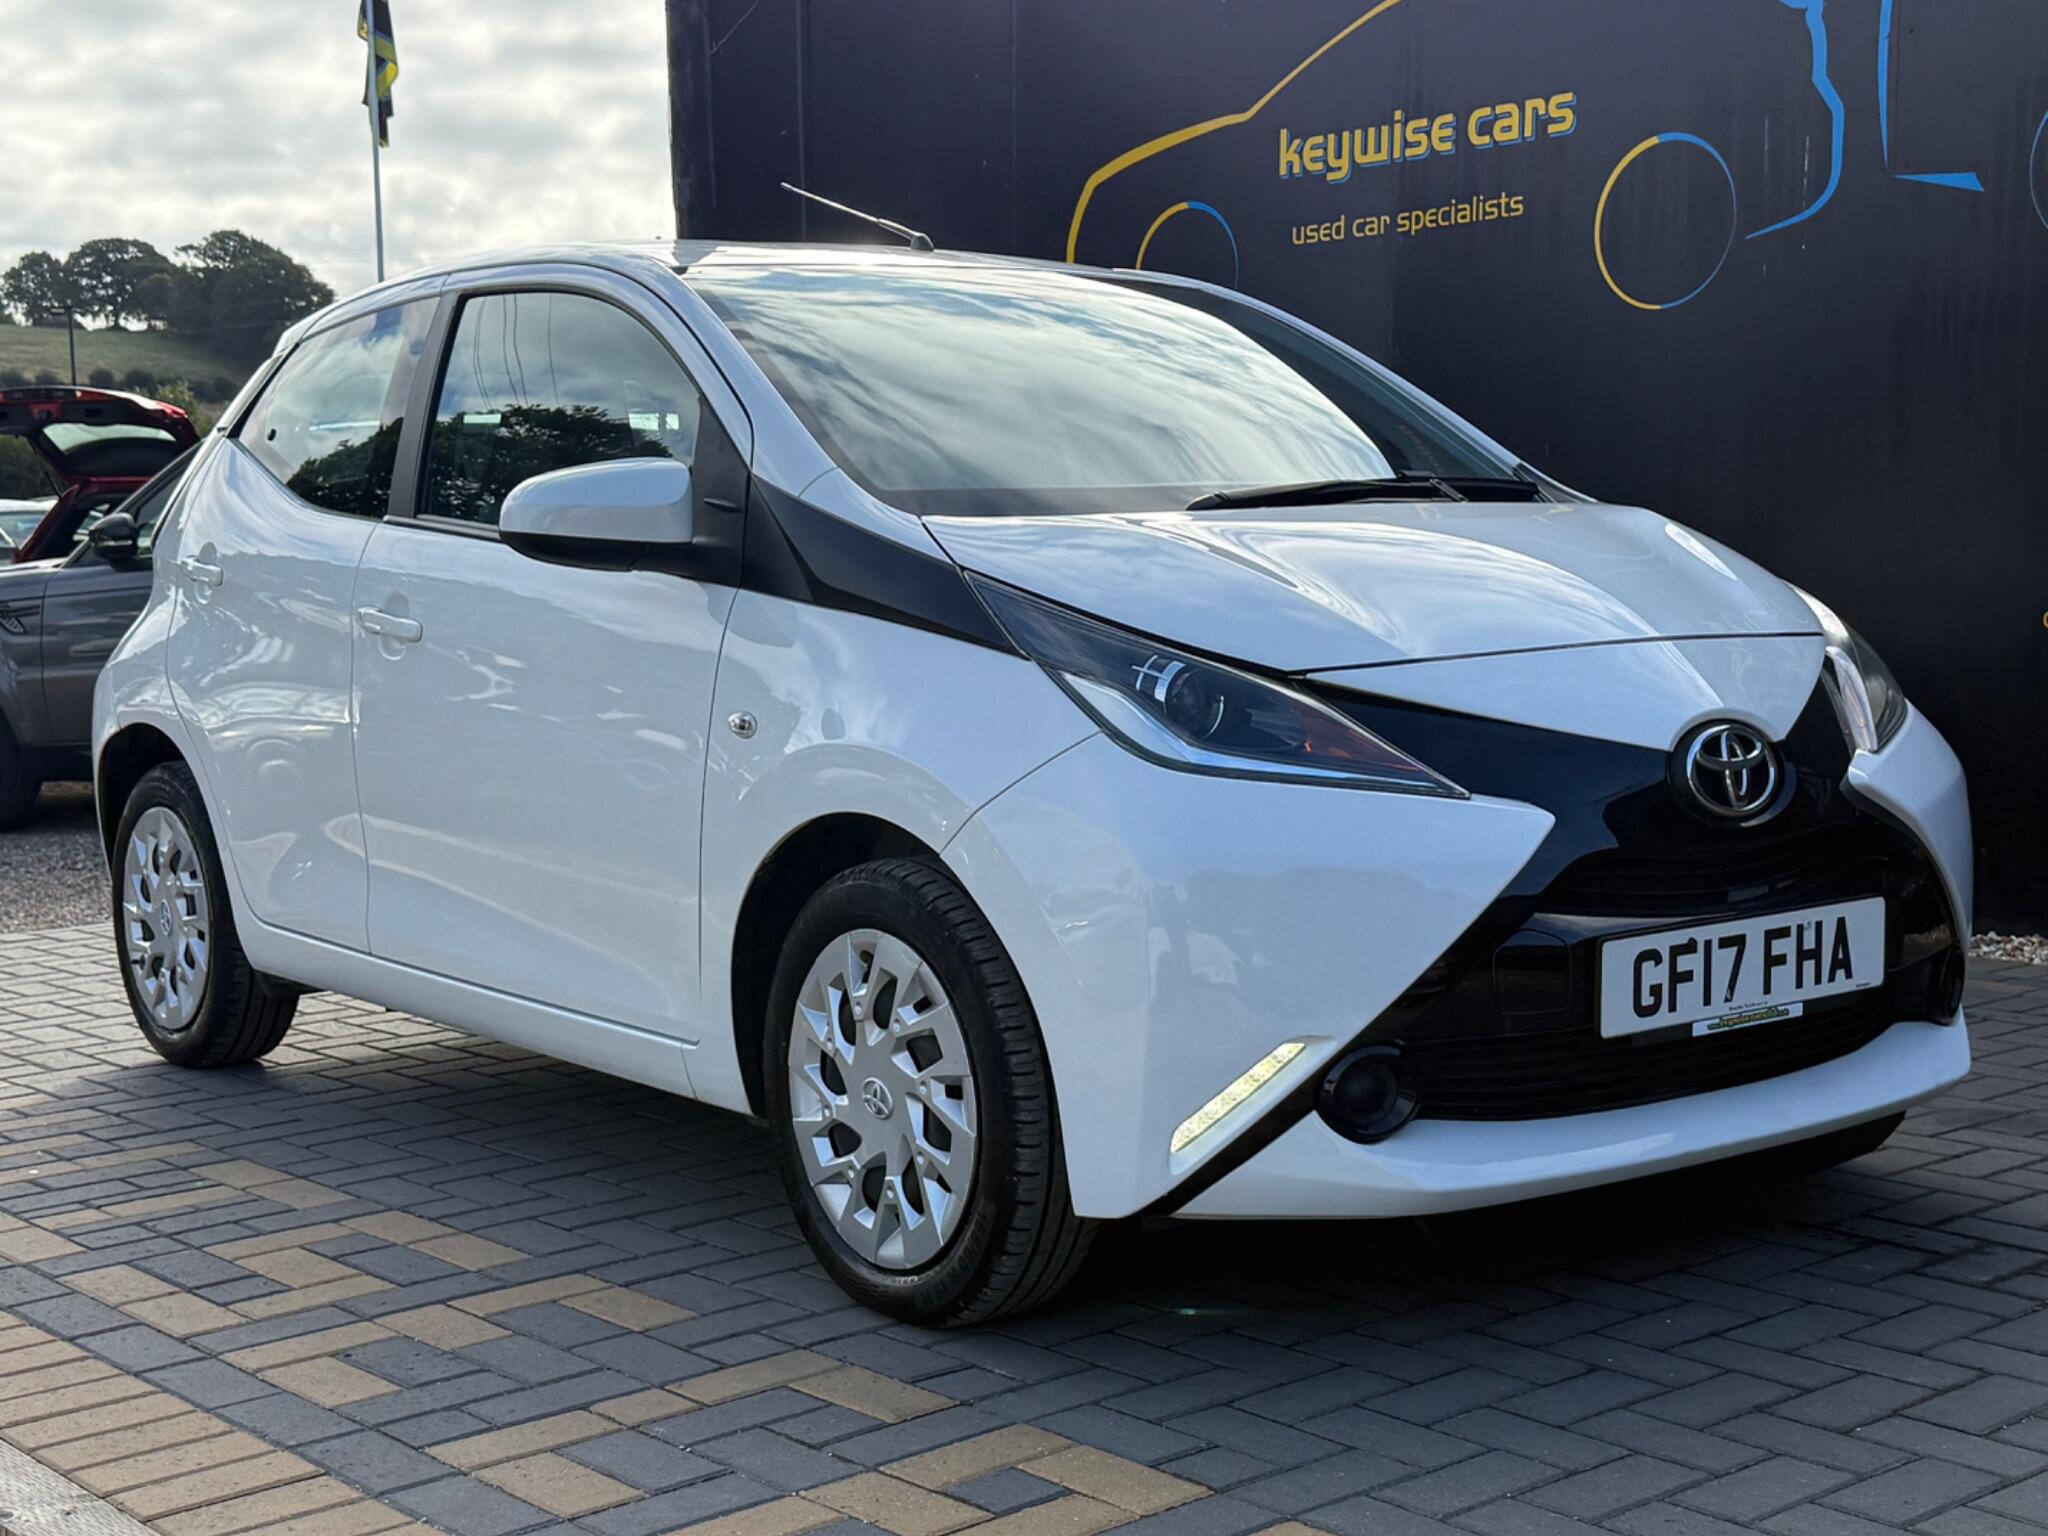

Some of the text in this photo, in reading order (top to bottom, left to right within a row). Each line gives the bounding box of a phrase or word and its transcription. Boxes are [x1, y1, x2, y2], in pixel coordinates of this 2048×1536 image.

[1278, 91, 1578, 184] keywise cars
[1291, 191, 1525, 246] used car specialists
[1632, 915, 1854, 1019] GF17 FHA
